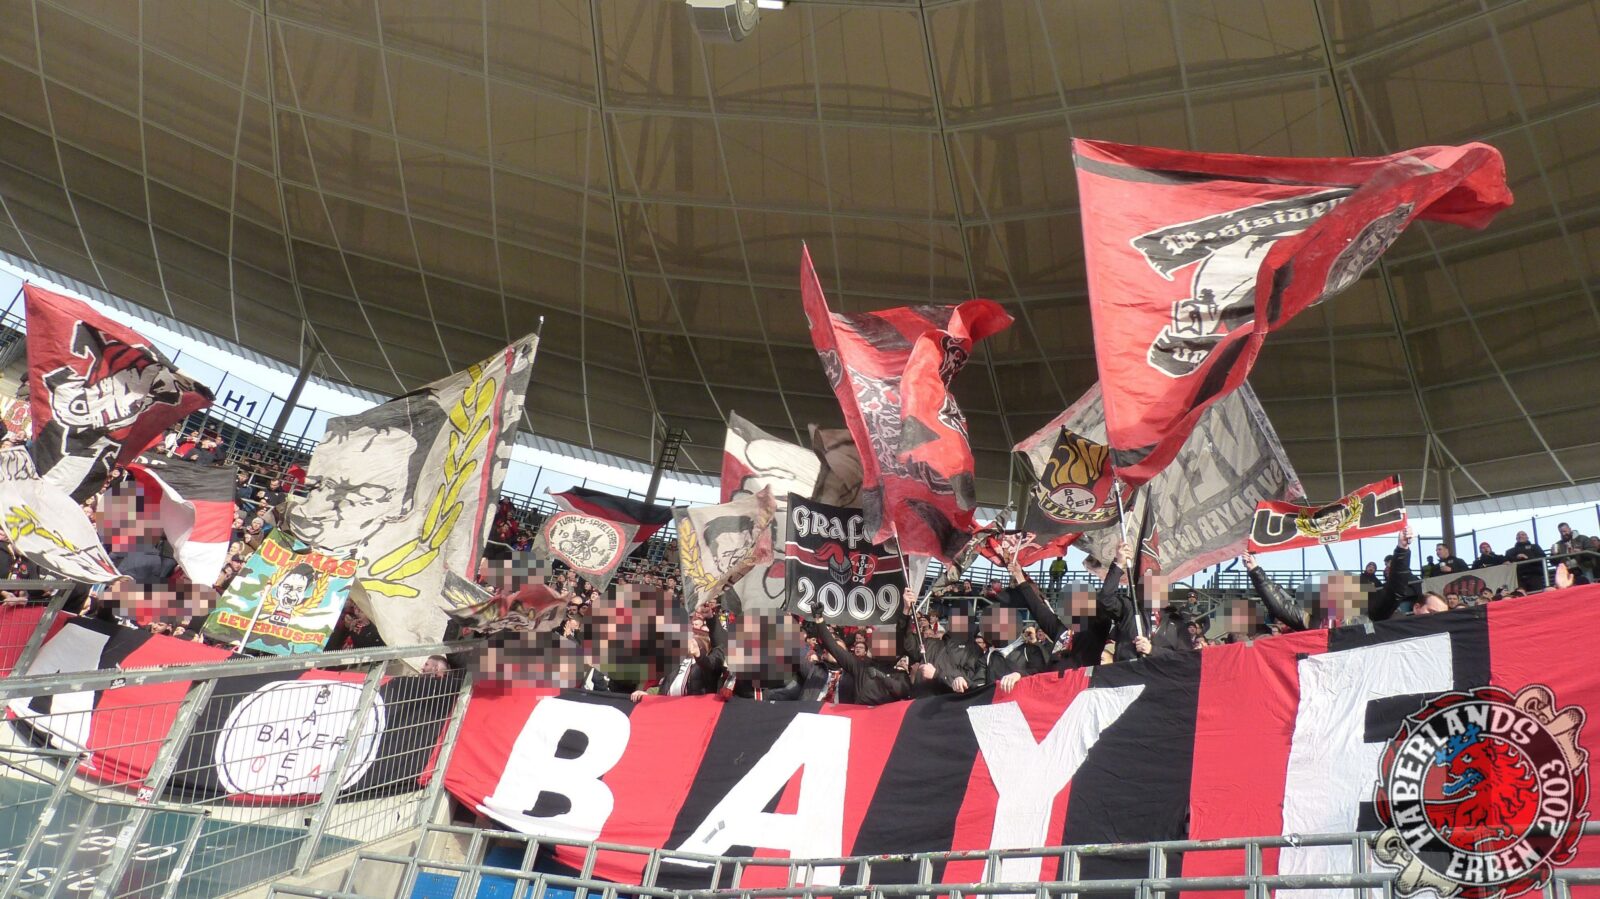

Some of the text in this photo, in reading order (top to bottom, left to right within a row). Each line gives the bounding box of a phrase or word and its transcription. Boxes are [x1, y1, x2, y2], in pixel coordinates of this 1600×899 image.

[1160, 195, 1347, 256] Wstside
[222, 390, 257, 418] H1
[797, 576, 901, 622] 2009
[217, 611, 326, 645] LEVERKUSEN
